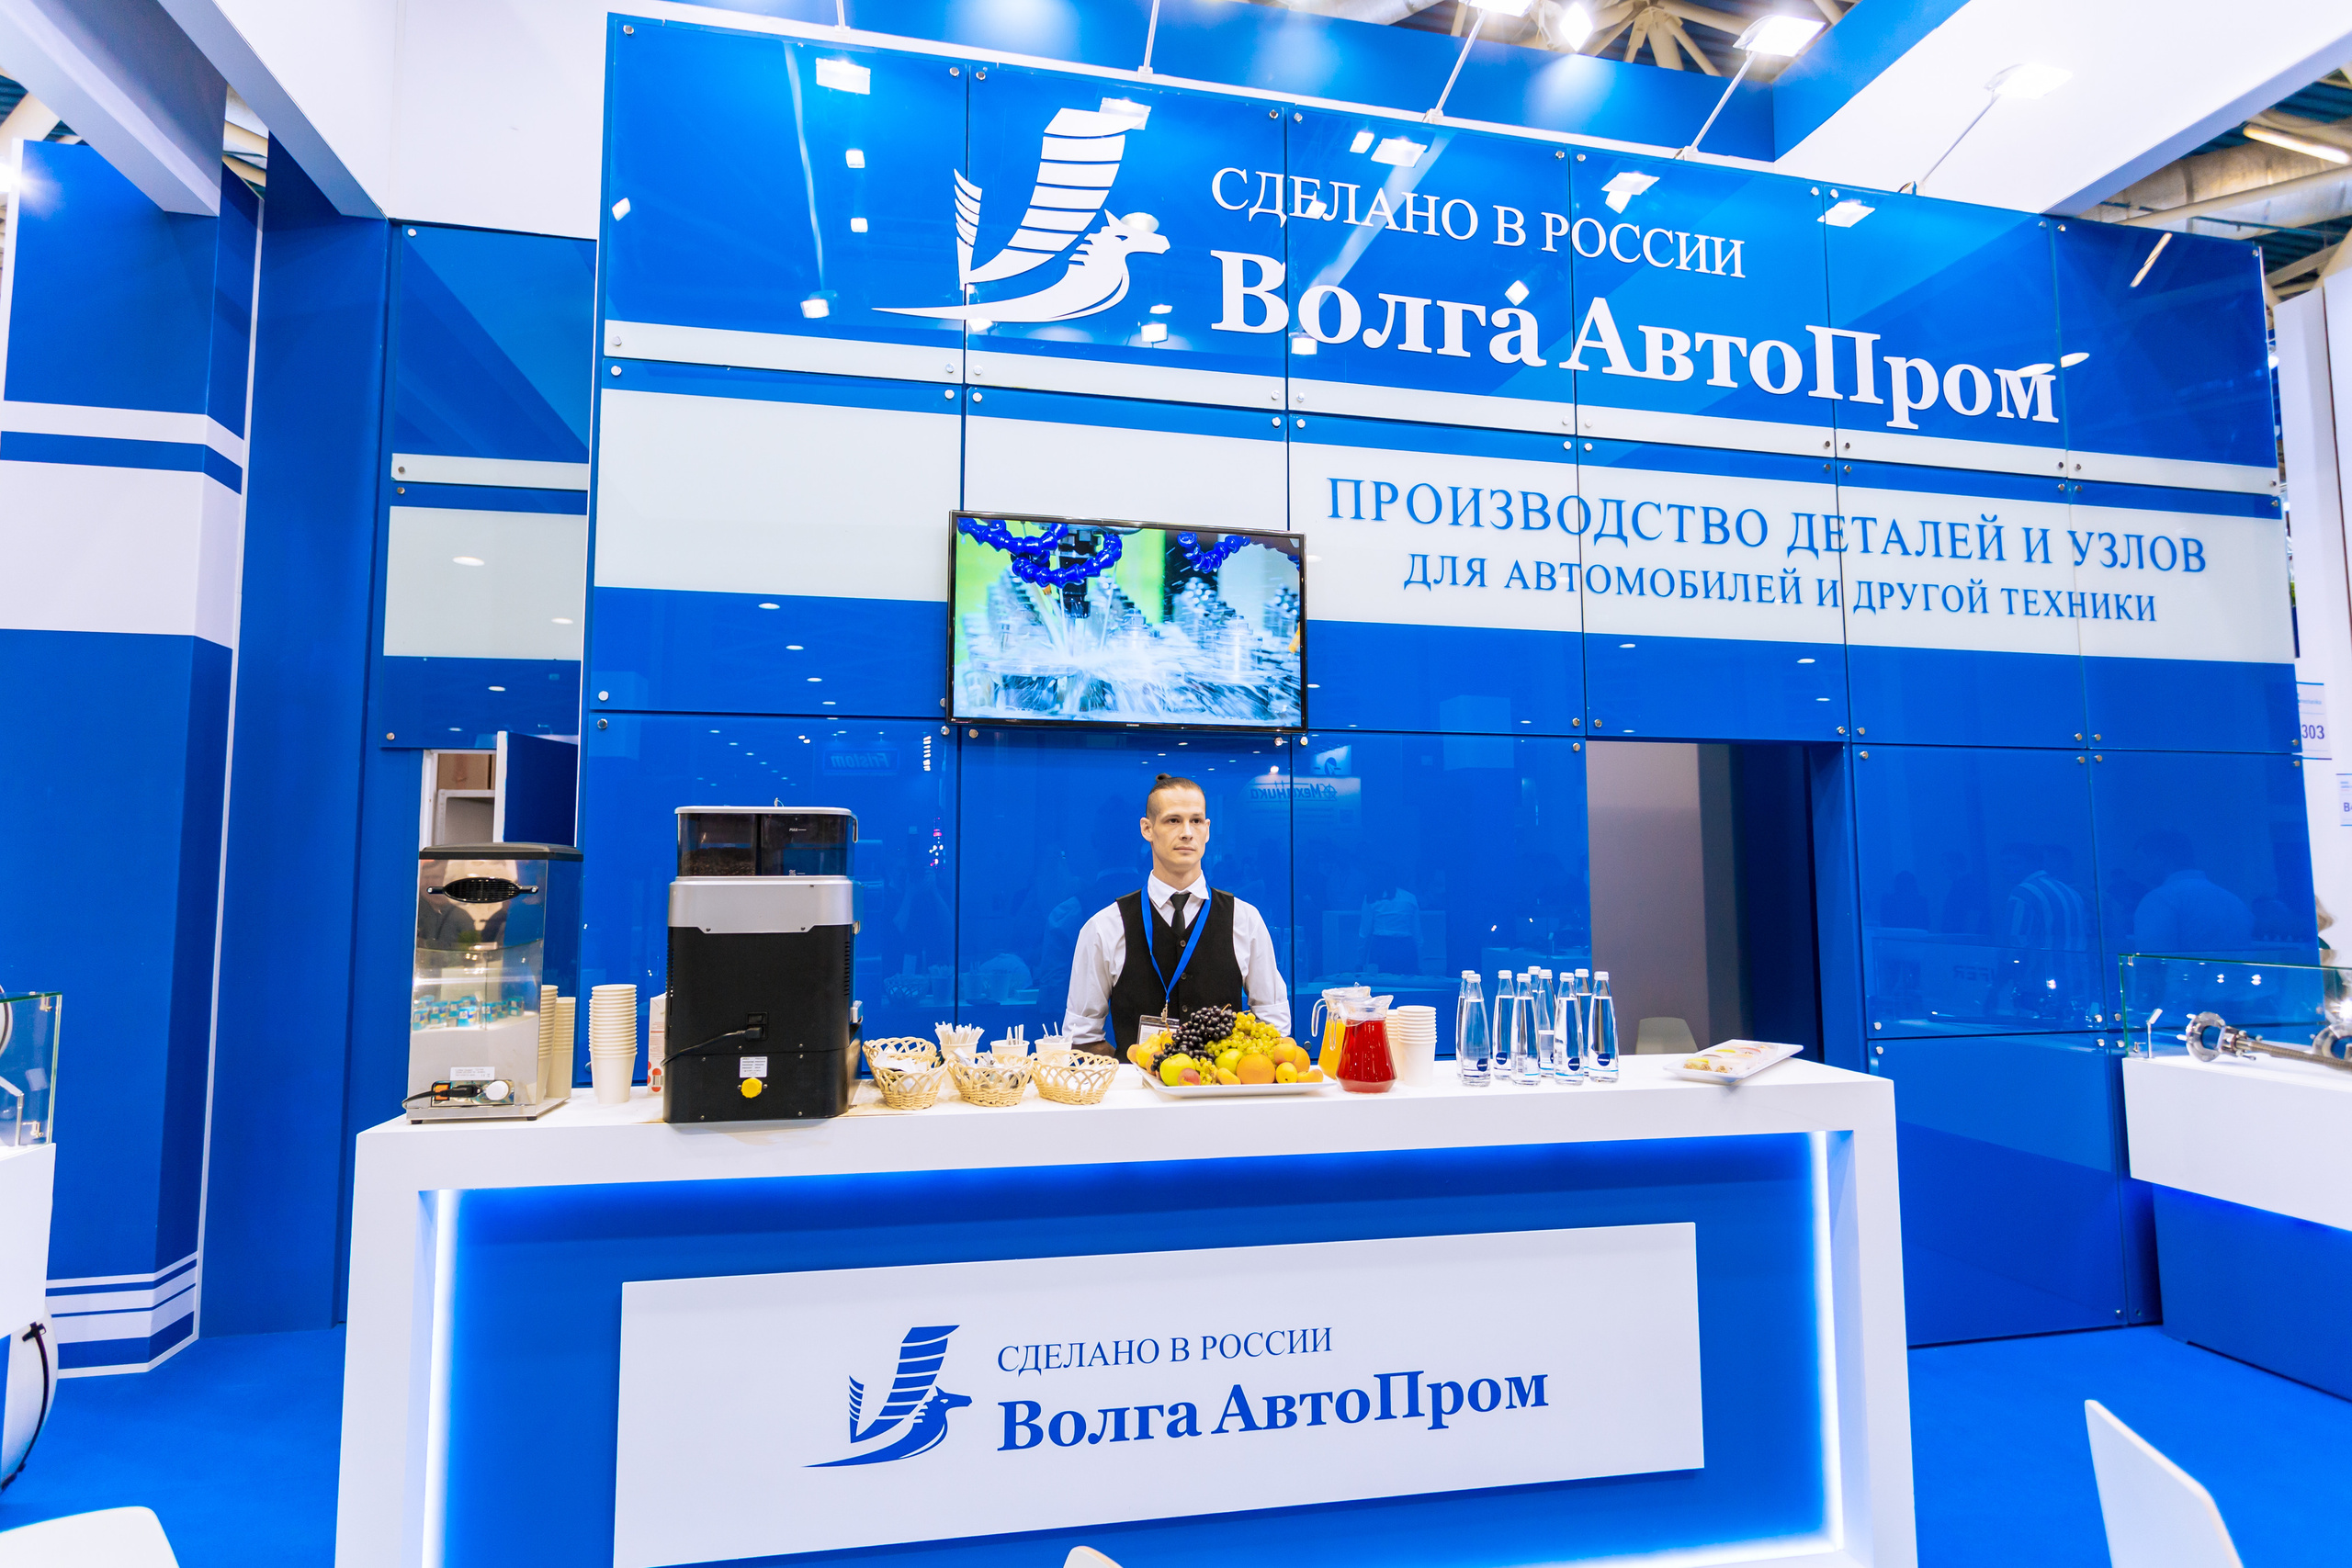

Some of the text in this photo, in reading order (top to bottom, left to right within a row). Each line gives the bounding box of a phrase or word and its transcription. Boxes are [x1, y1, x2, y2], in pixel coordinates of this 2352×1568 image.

[1211, 167, 1747, 278] СДЕЛАНО В РОССИИ
[1210, 250, 2060, 430] Волга АвтоПром
[1328, 478, 2207, 573] ПРОИЗВОДСТВО ДЕТАЛЕЙ И УЗЛОВ
[1403, 553, 2156, 622] ДЛЯ АВТОМОБИЛЕЙ И ДРУГОЙ ТЕХНИКИ
[997, 1326, 1331, 1377] СДЕЛАНО В РОССИИ
[997, 1370, 1549, 1451] Волга АвтоПром
